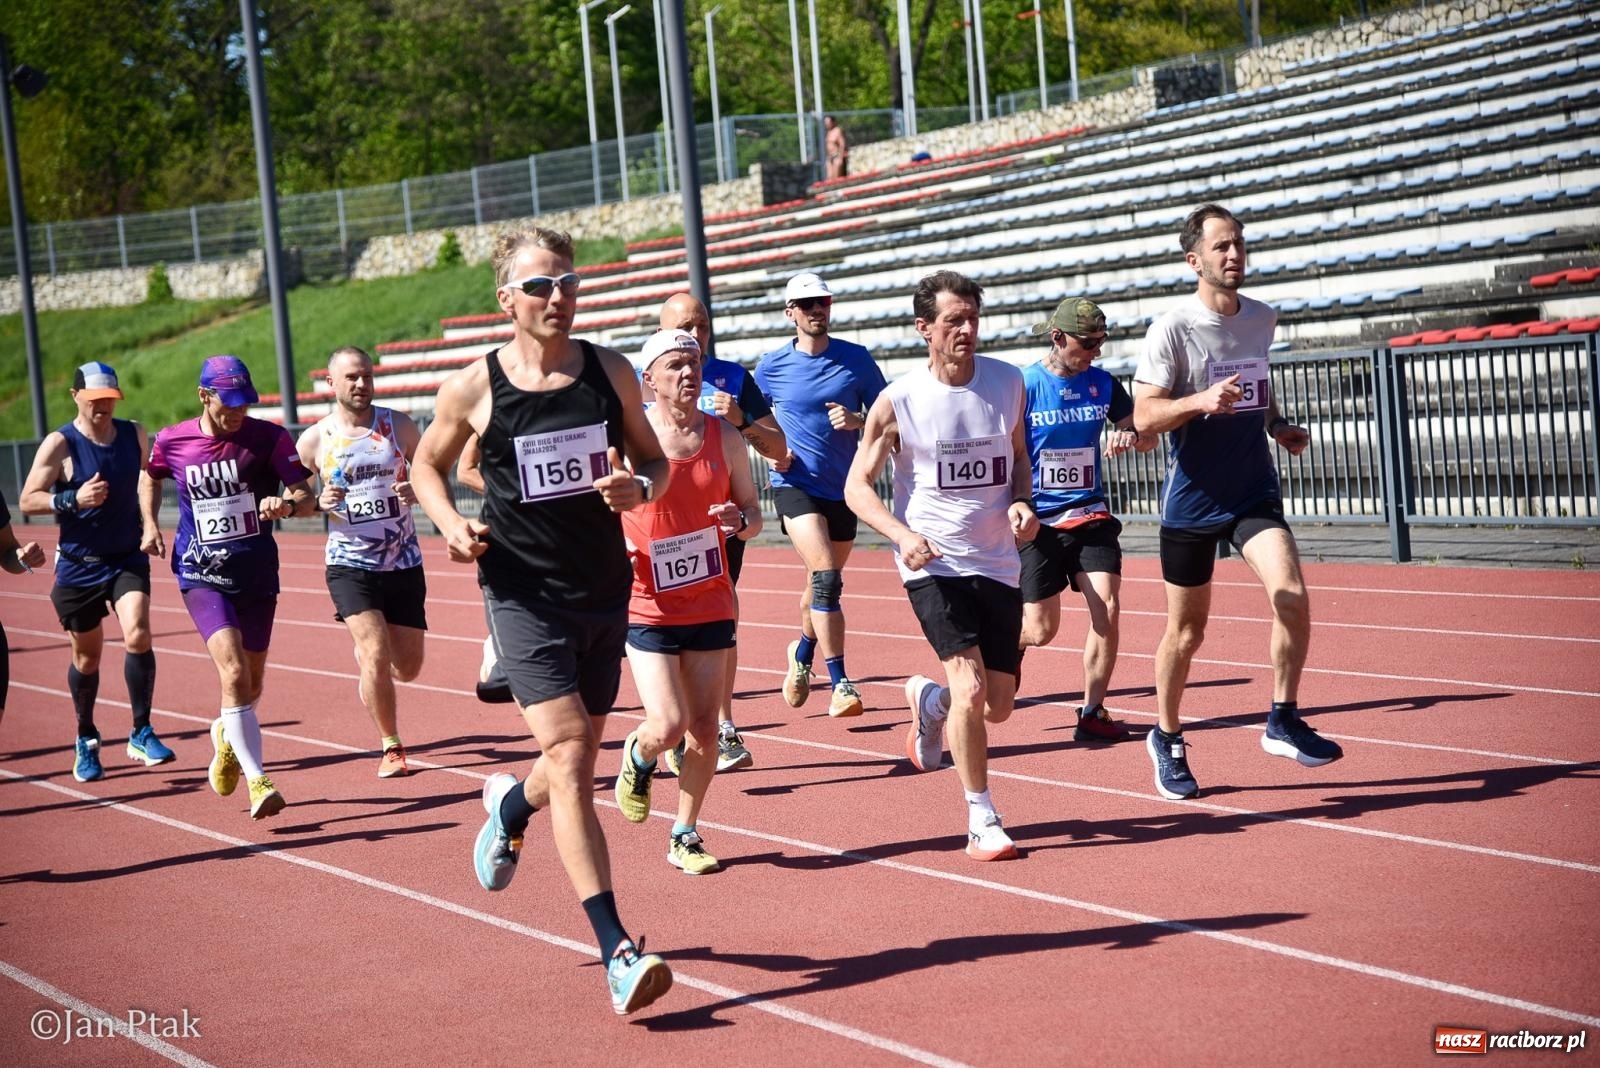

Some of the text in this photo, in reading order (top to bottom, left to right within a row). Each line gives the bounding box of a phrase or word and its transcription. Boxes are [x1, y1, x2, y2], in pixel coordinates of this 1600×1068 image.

[1030, 403, 1110, 427] RUNNERS
[522, 432, 587, 449] XVIII BIEG BEZ GRANIC
[185, 459, 239, 500] RUN
[534, 458, 583, 487] 156
[948, 460, 987, 481] 140
[1049, 467, 1079, 483] 166
[353, 500, 386, 518] 238
[207, 515, 238, 535] 231
[678, 538, 686, 546] BEZ
[665, 554, 699, 580] 167
